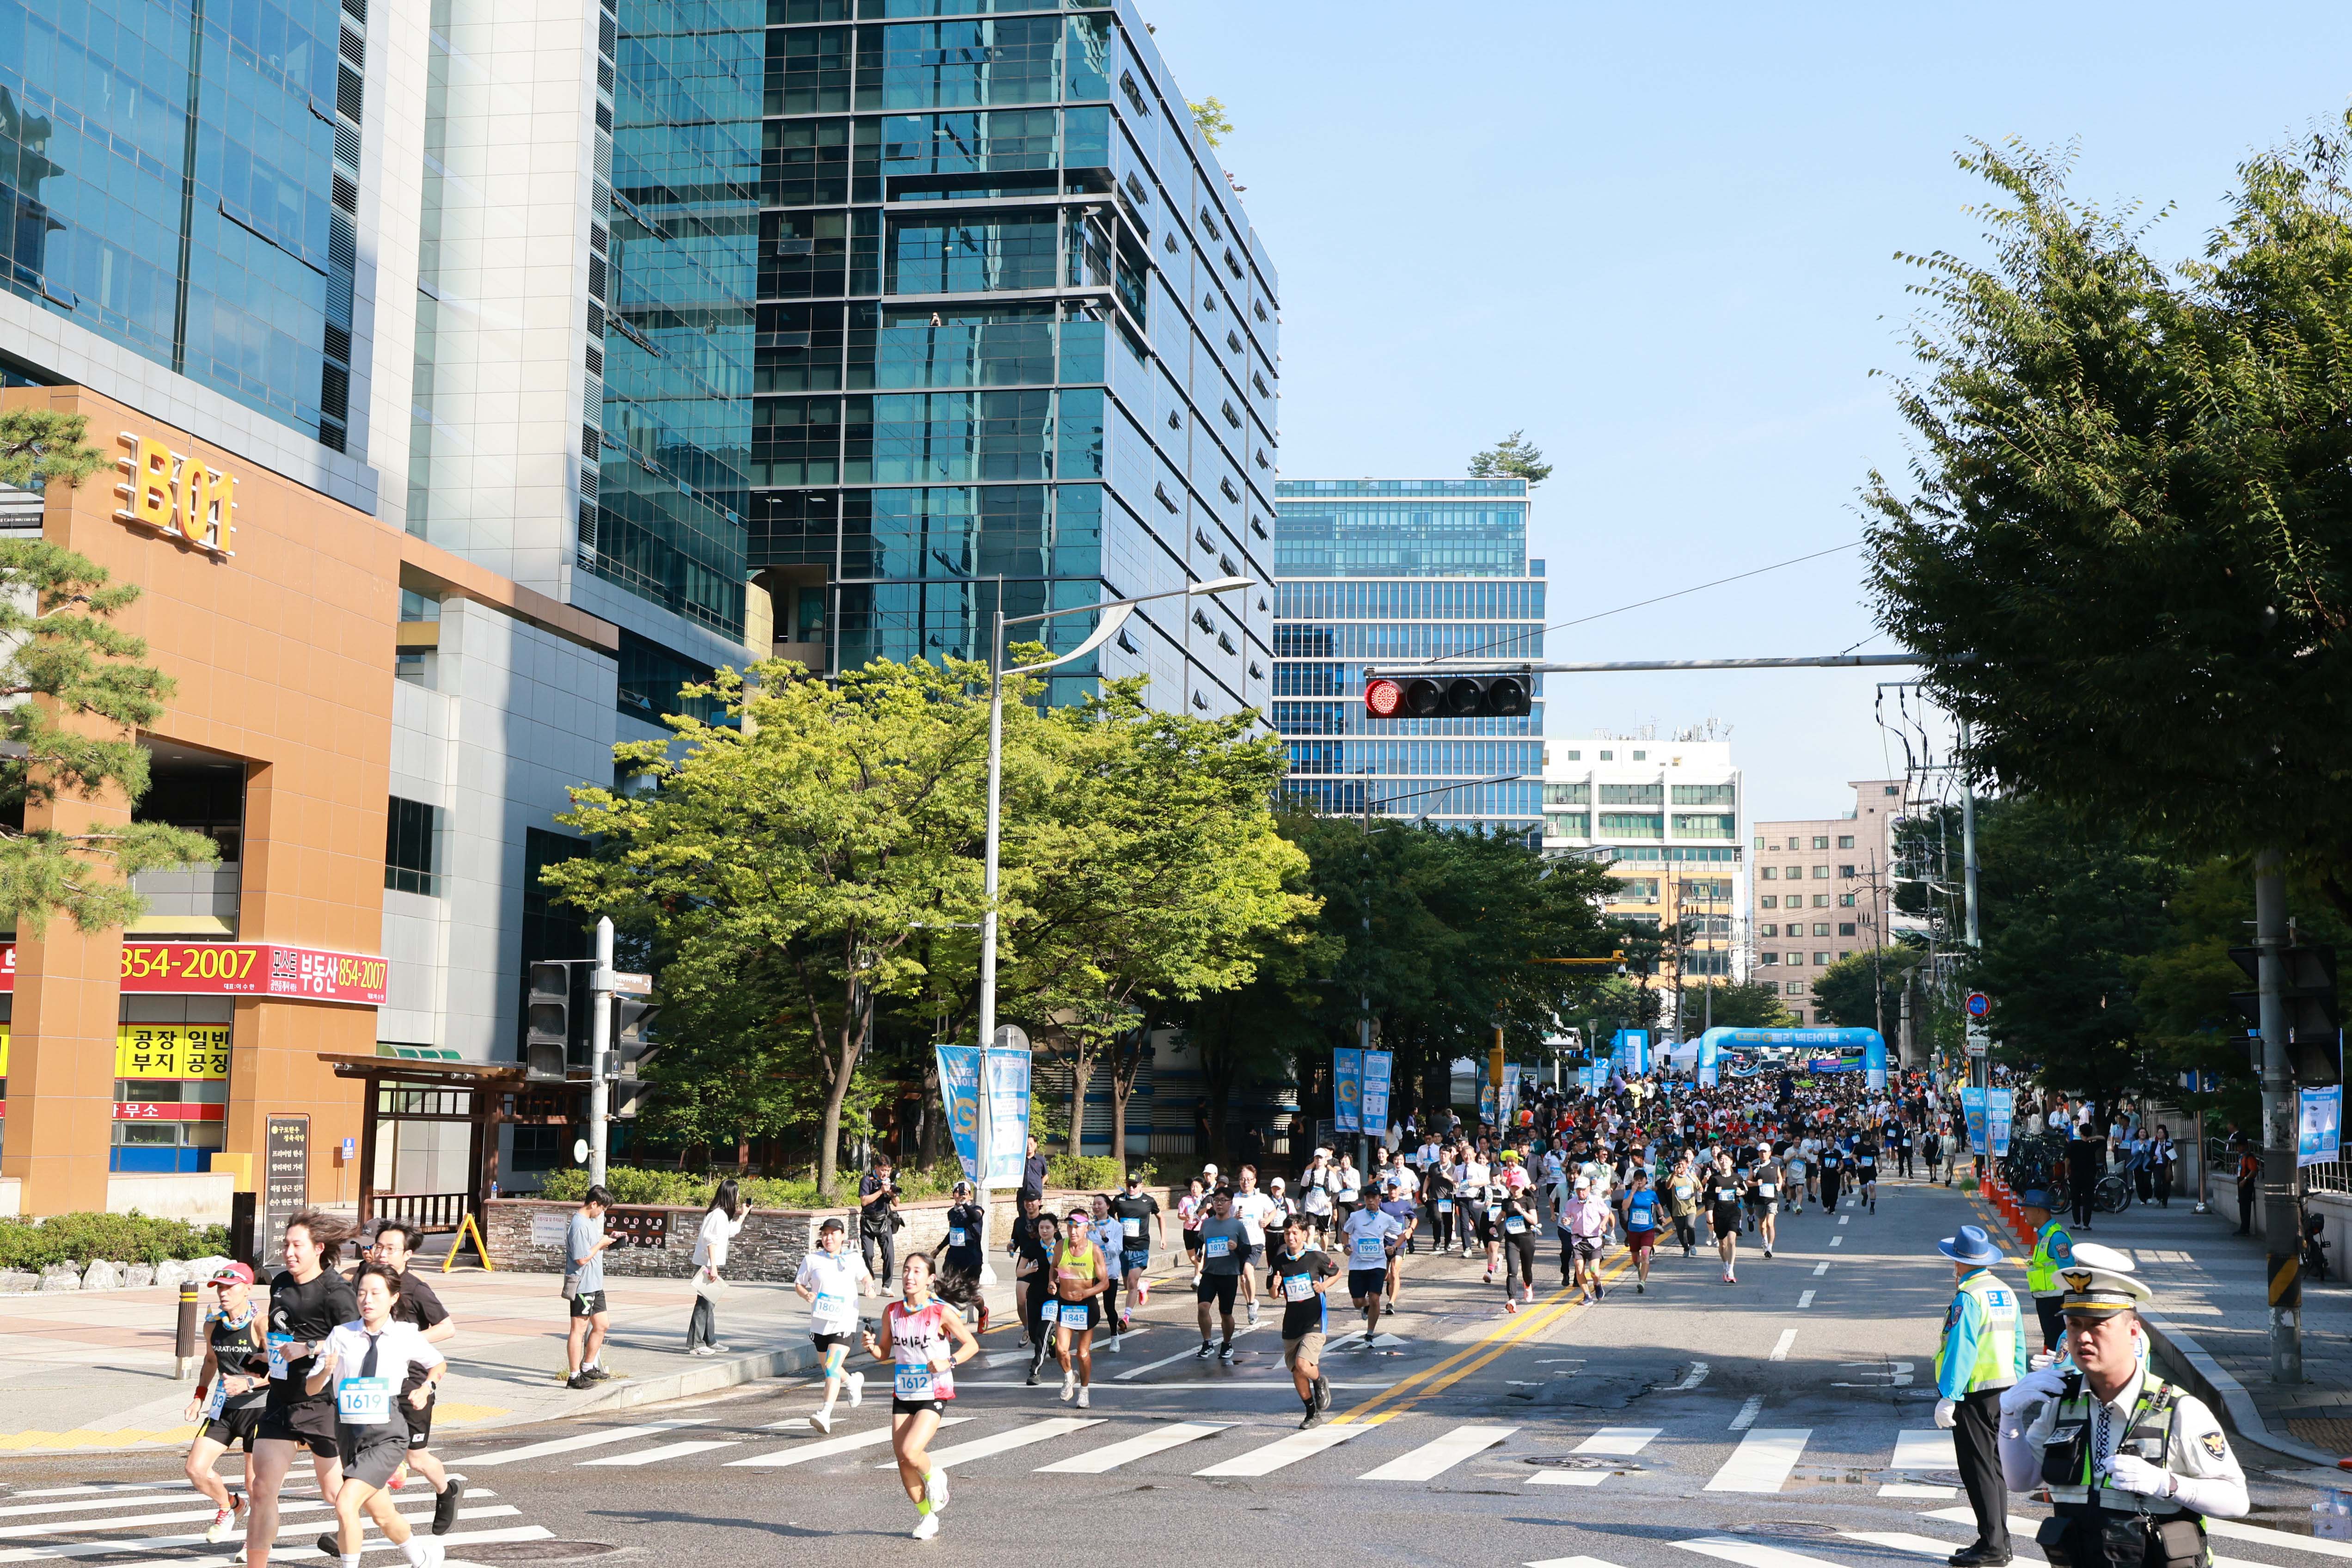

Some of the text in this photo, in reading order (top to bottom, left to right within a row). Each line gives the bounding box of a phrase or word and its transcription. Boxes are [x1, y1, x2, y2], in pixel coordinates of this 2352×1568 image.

[120, 947, 257, 979] 854-2007
[272, 950, 297, 979] 포스트
[300, 954, 338, 993] 부동산
[338, 958, 386, 990] 854-2007
[270, 980, 290, 992] 공인중개사
[134, 1030, 177, 1050] 공장
[1795, 1032, 1827, 1043] 넥타이
[1829, 1032, 1839, 1043] 런
[132, 1054, 174, 1072] 부지
[278, 1126, 300, 1134] 구로한우
[1988, 1292, 2012, 1305] 모범
[819, 1301, 840, 1313] 1806
[1065, 1314, 1084, 1323] 1845
[901, 1377, 928, 1389] 1612
[346, 1394, 381, 1409] 1619
